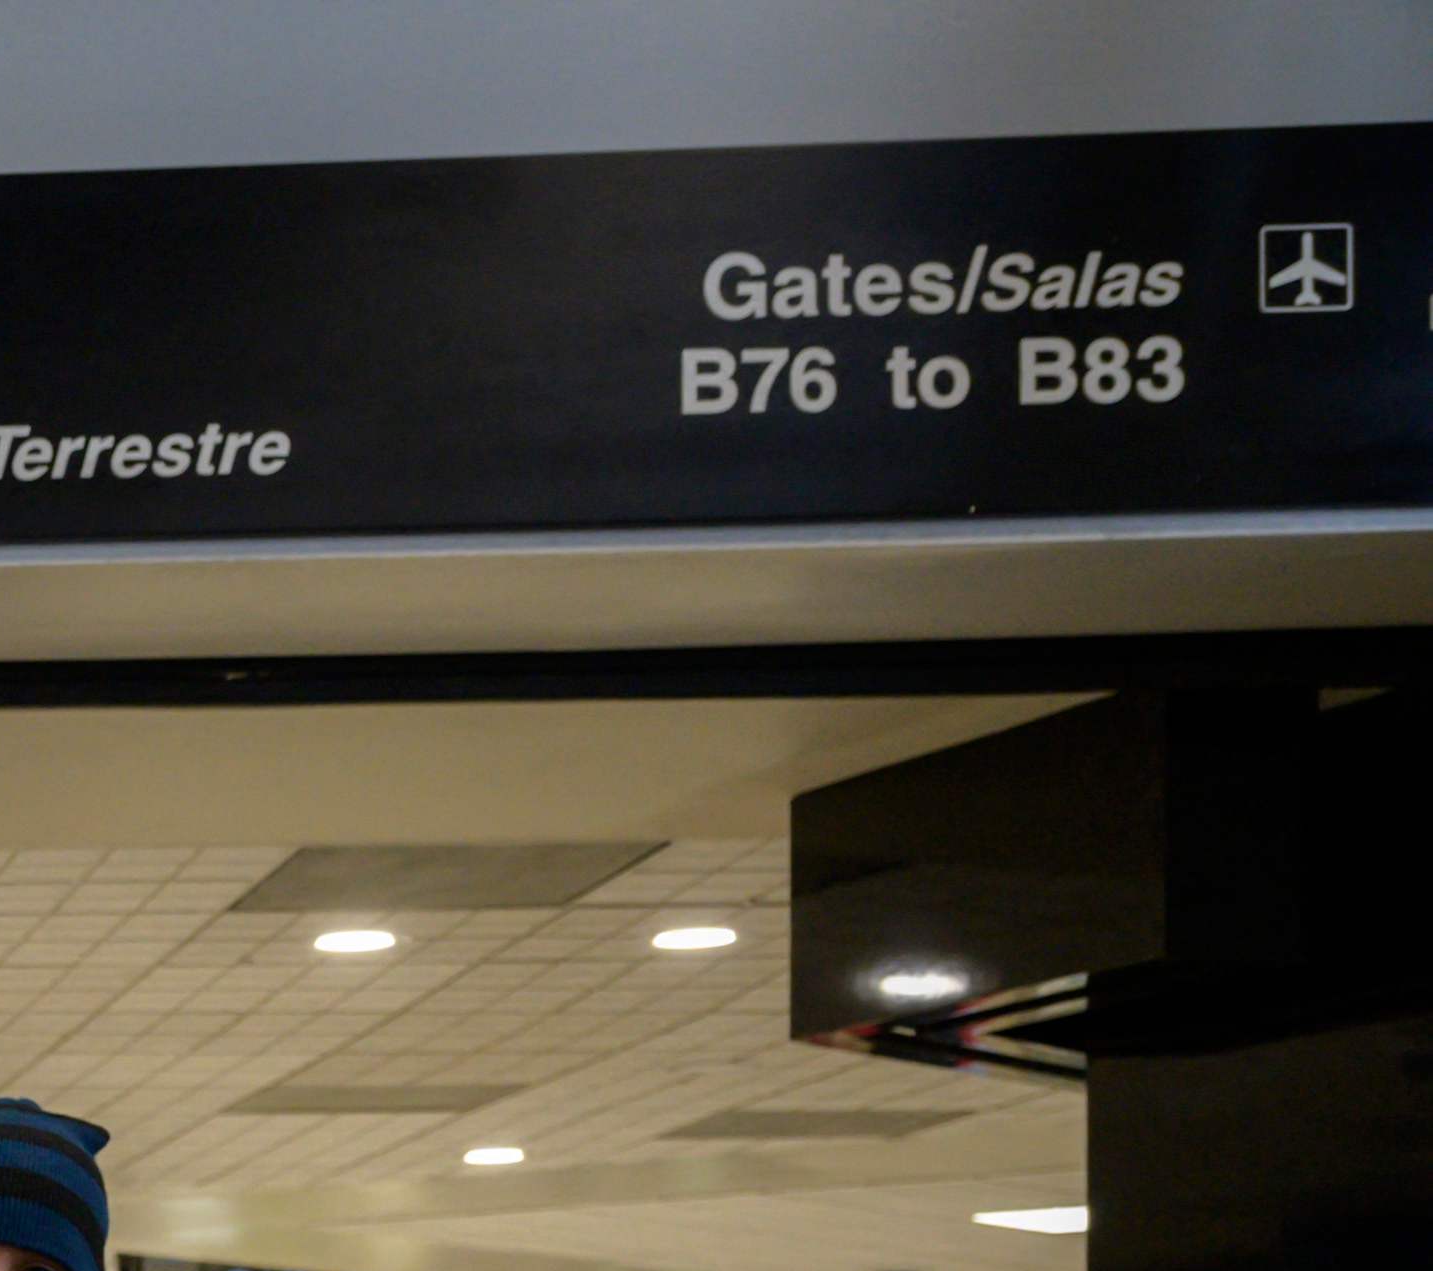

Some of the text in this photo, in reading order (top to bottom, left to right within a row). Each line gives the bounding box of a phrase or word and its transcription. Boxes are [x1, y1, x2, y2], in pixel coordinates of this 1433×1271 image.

[703, 244, 1184, 321] Gates/Salas
[680, 335, 1187, 416] B76 to B83
